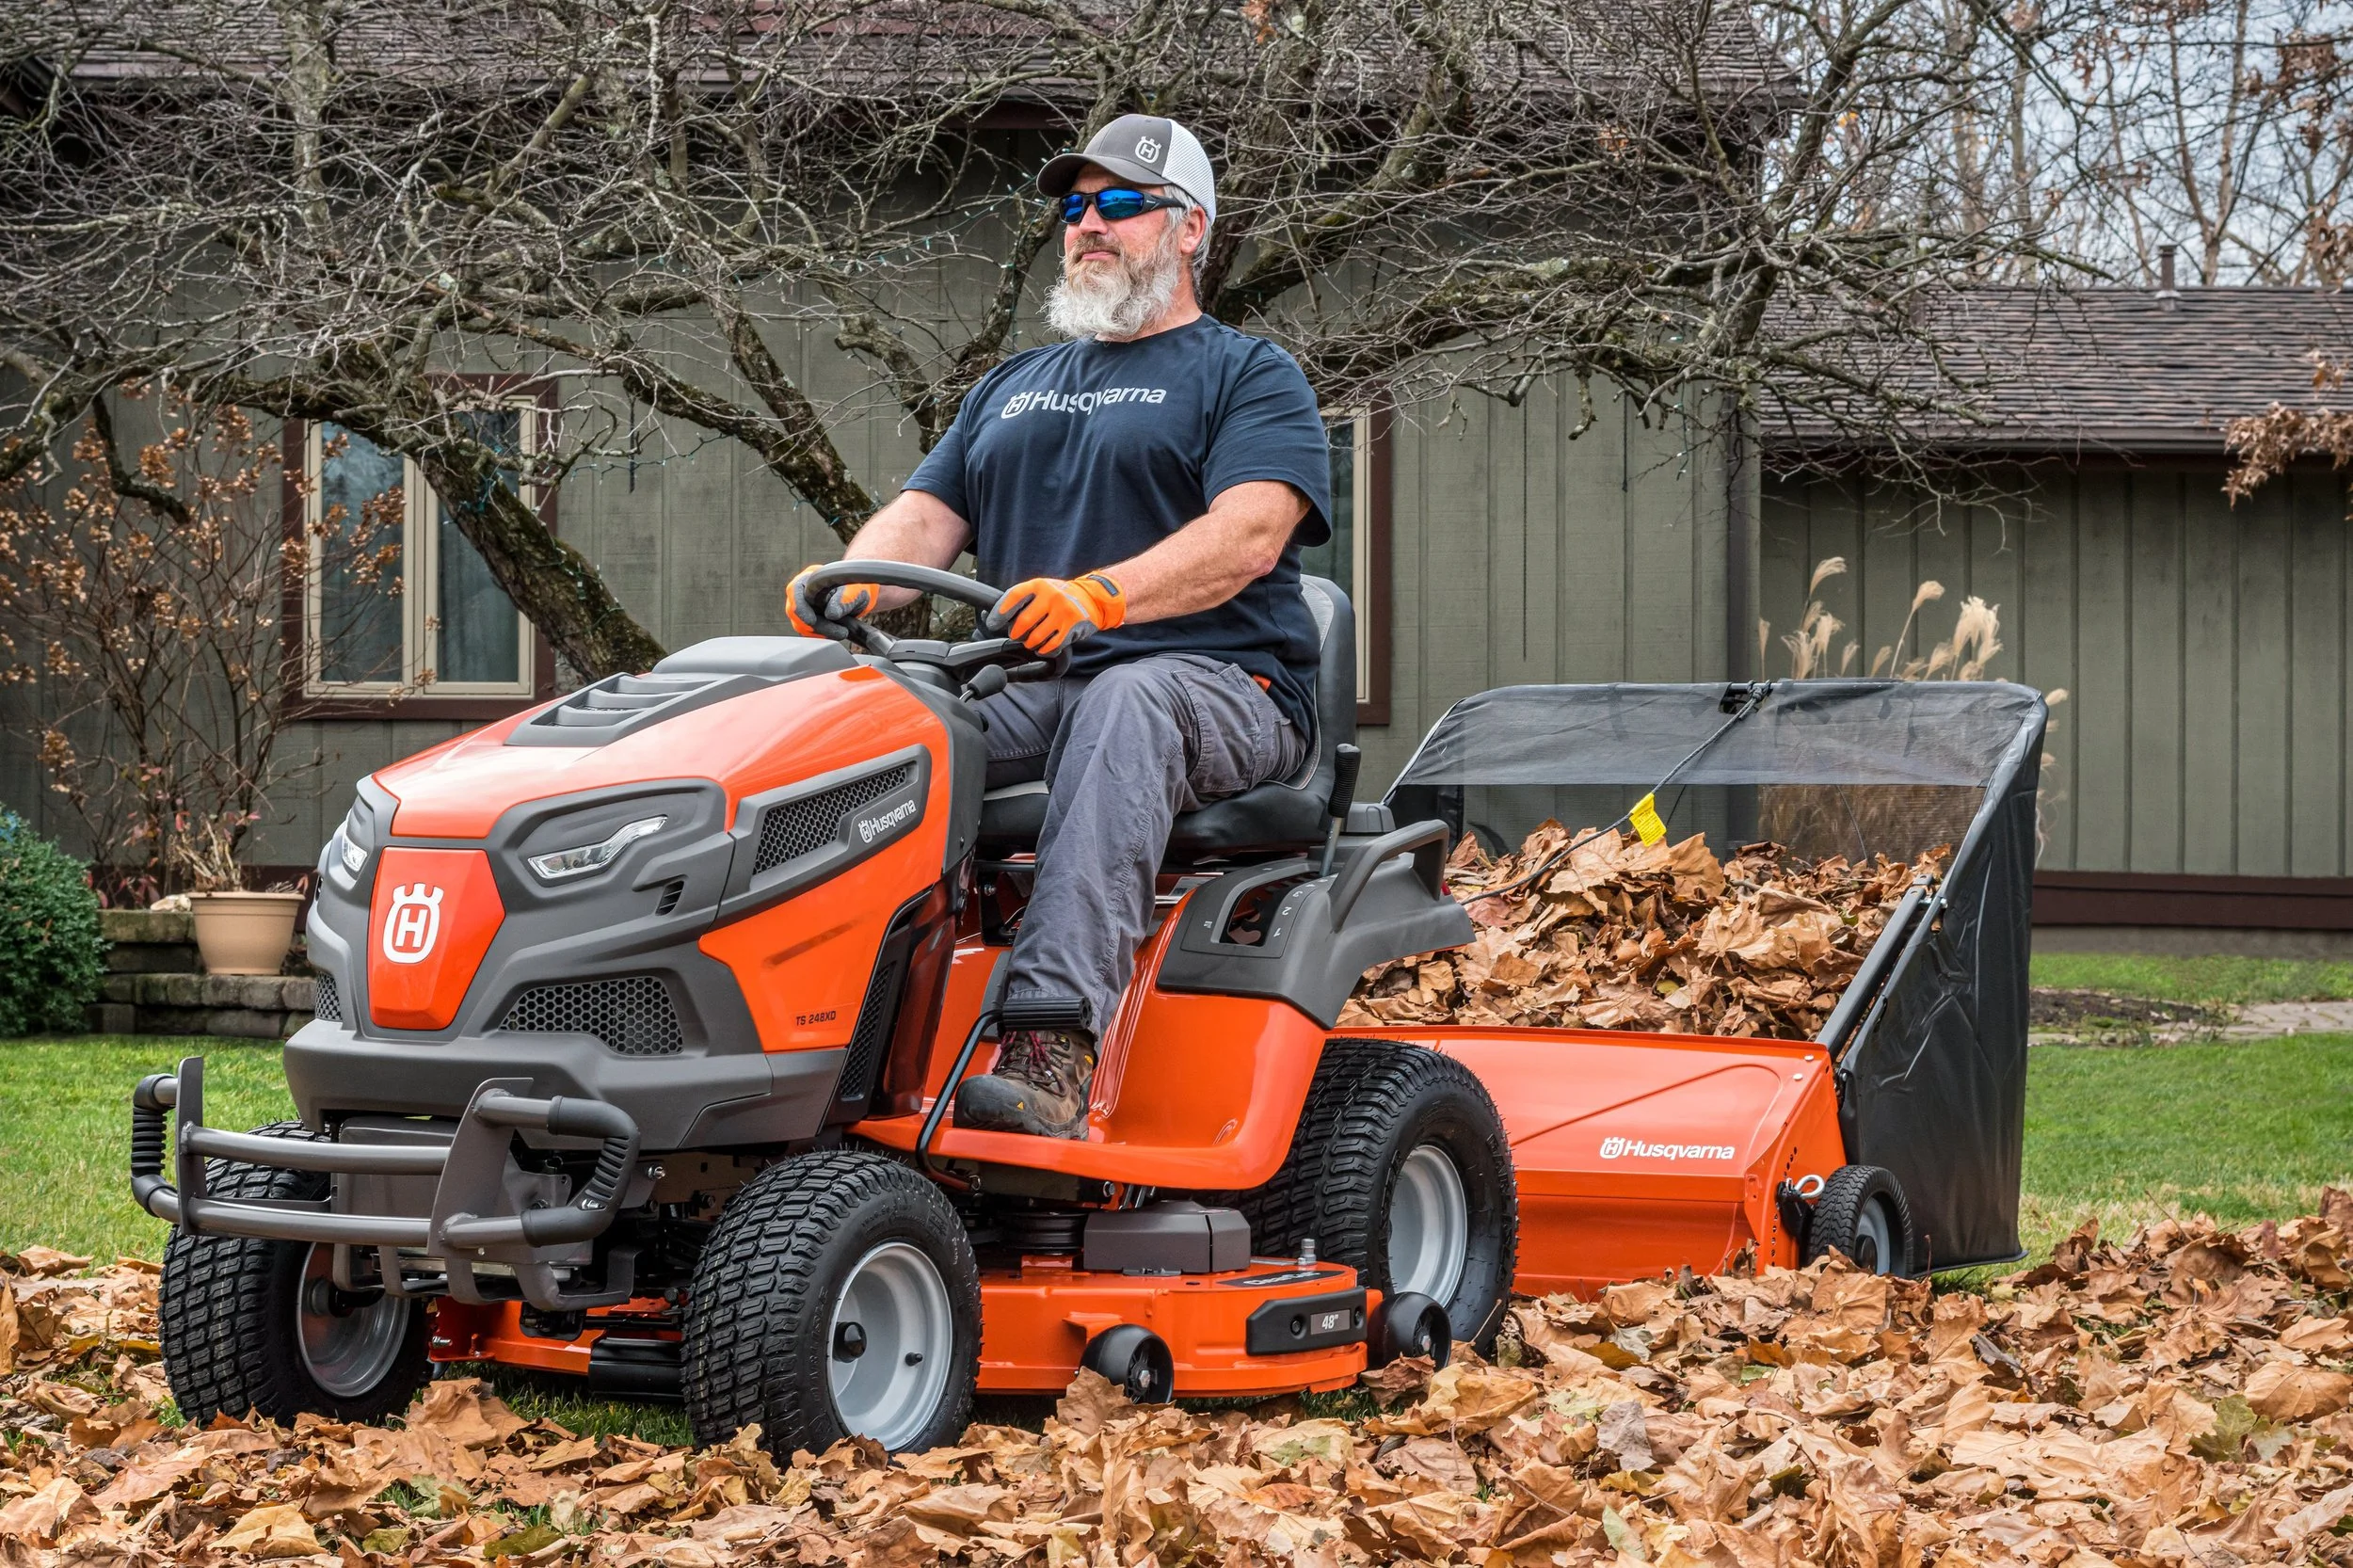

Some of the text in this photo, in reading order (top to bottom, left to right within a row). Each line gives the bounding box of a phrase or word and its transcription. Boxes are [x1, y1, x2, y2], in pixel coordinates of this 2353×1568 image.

[1028, 387, 1167, 416] Husqvarna
[868, 799, 917, 836] Husqvarna
[1281, 905, 1292, 916] 2
[1273, 927, 1282, 938] 1
[795, 1010, 837, 1026] TS 248XD
[1623, 1140, 1736, 1160] Husqvarna
